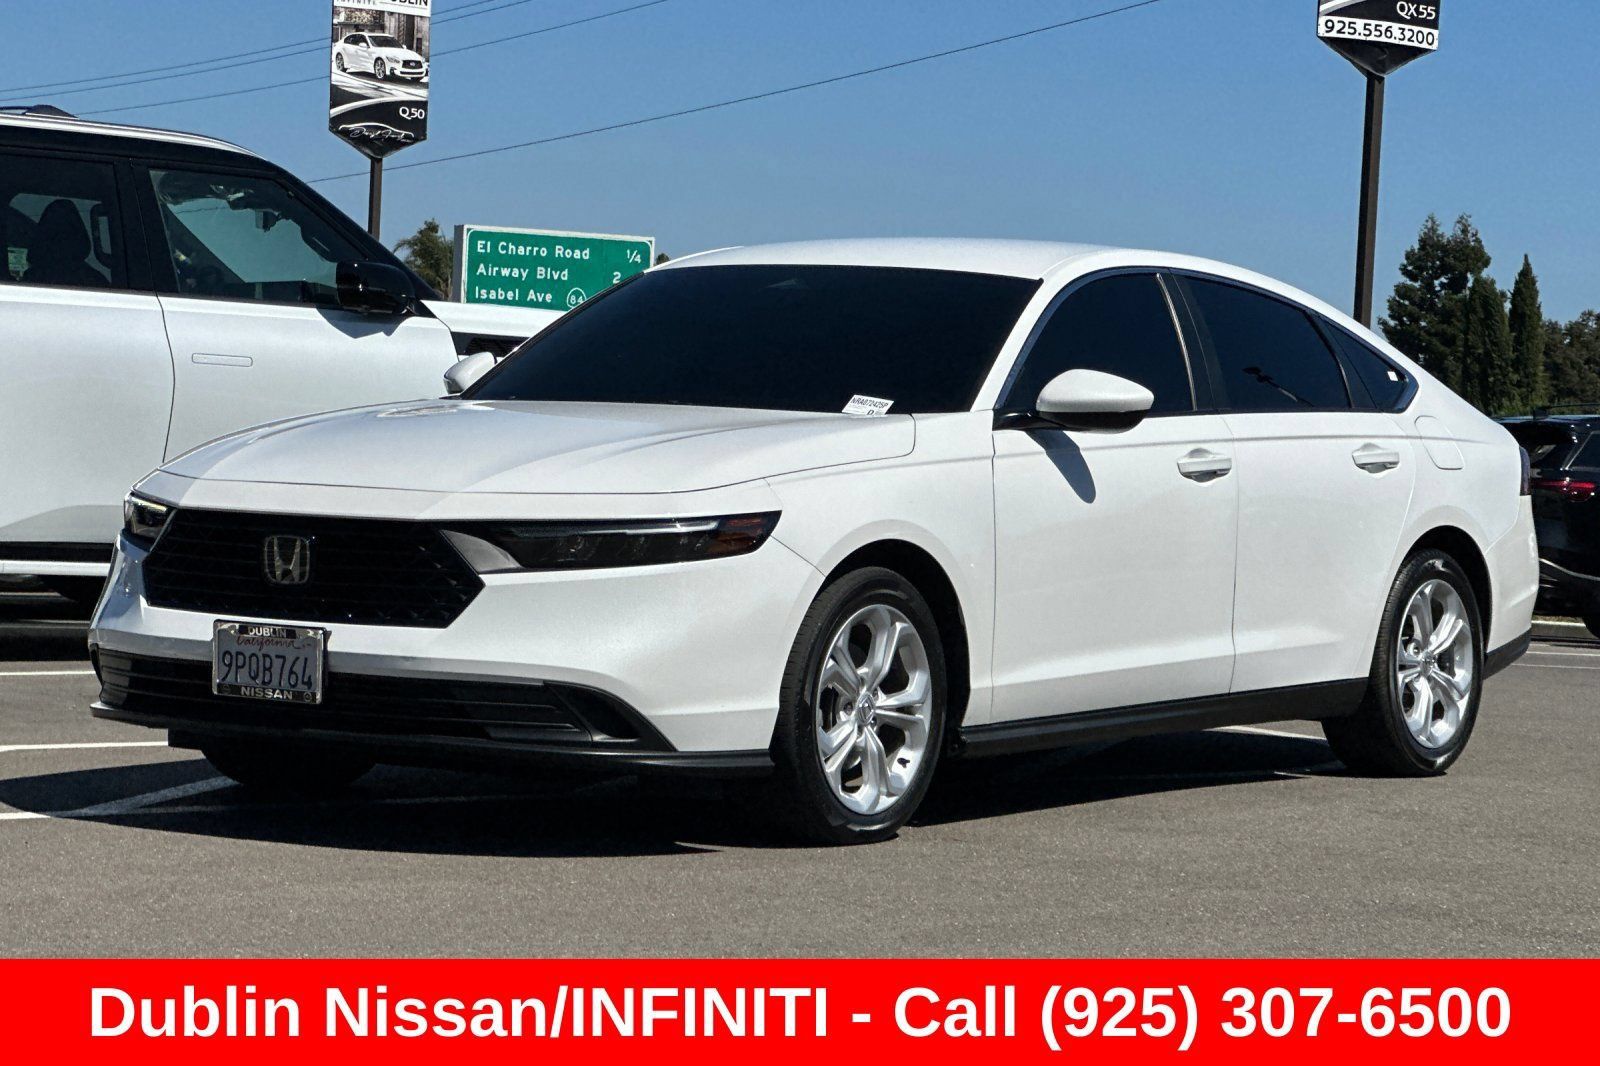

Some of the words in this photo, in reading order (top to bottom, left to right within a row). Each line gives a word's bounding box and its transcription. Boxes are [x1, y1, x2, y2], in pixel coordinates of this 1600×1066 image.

[1396, 1, 1436, 19] QX55
[1324, 19, 1435, 46] 925.556.3200
[399, 106, 425, 120] Q50
[477, 240, 491, 253] El
[498, 242, 548, 257] Charro
[555, 245, 590, 260] Road
[476, 263, 529, 281] Airway
[536, 266, 569, 281] Blvd
[612, 272, 622, 284] 2
[475, 286, 519, 301] Isabel
[527, 289, 553, 303] Ave
[570, 295, 584, 305] 84
[247, 626, 287, 638] DUBLIN
[237, 637, 298, 651] California
[221, 650, 313, 690] 9PQB764
[240, 686, 293, 700] NISSAN
